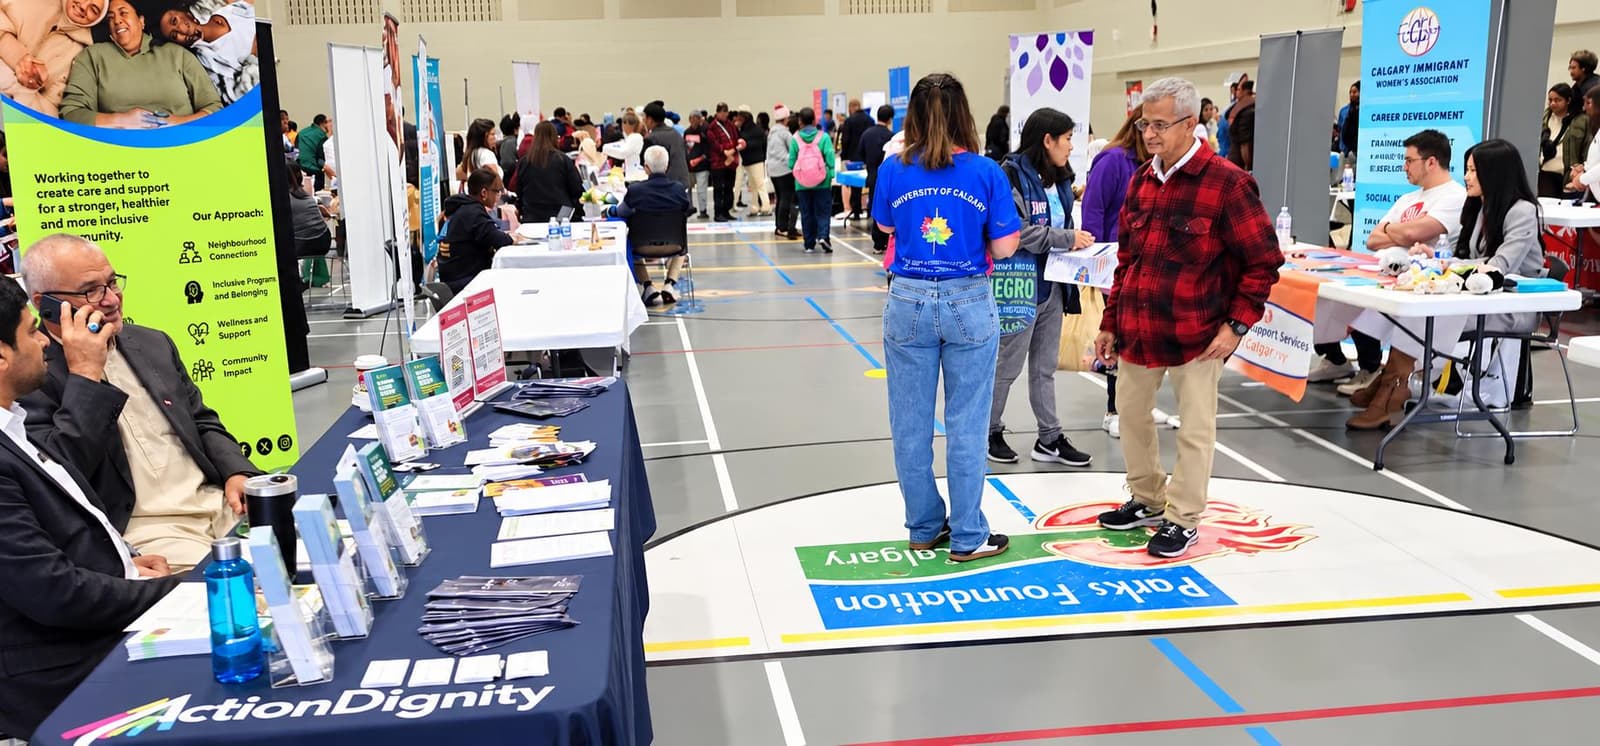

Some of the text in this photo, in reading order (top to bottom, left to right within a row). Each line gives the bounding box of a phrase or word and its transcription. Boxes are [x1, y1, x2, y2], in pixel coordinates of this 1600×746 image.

[1371, 59, 1470, 77] CALGARY IMMIGRANT
[1376, 75, 1458, 88] WOMEN'S ASSOCIATION
[1371, 110, 1464, 122] CAREER DEVELOPMENT
[34, 170, 149, 184] Working together to
[37, 183, 170, 199] create care and support
[1366, 193, 1391, 202] SOCIAL
[891, 187, 939, 209] UNIVERSITY
[941, 187, 952, 196] OF
[38, 197, 170, 214] for a stronger, healthier
[192, 208, 264, 221] Our Approach:
[41, 213, 149, 230] and more inclusive
[208, 237, 267, 250] Neighbourhood
[209, 250, 258, 261] Connections
[212, 278, 246, 288] Inclusive
[993, 277, 1035, 300] EGRO
[214, 288, 268, 300] and Belonging
[217, 315, 268, 328] Wellness and
[219, 329, 251, 340] Support
[1280, 332, 1309, 352] Services
[222, 353, 268, 366] Community
[223, 367, 252, 378] Impact
[825, 546, 958, 568] algary
[835, 576, 1210, 616] Parks Foundation
[90, 685, 555, 738] ActionDignity
